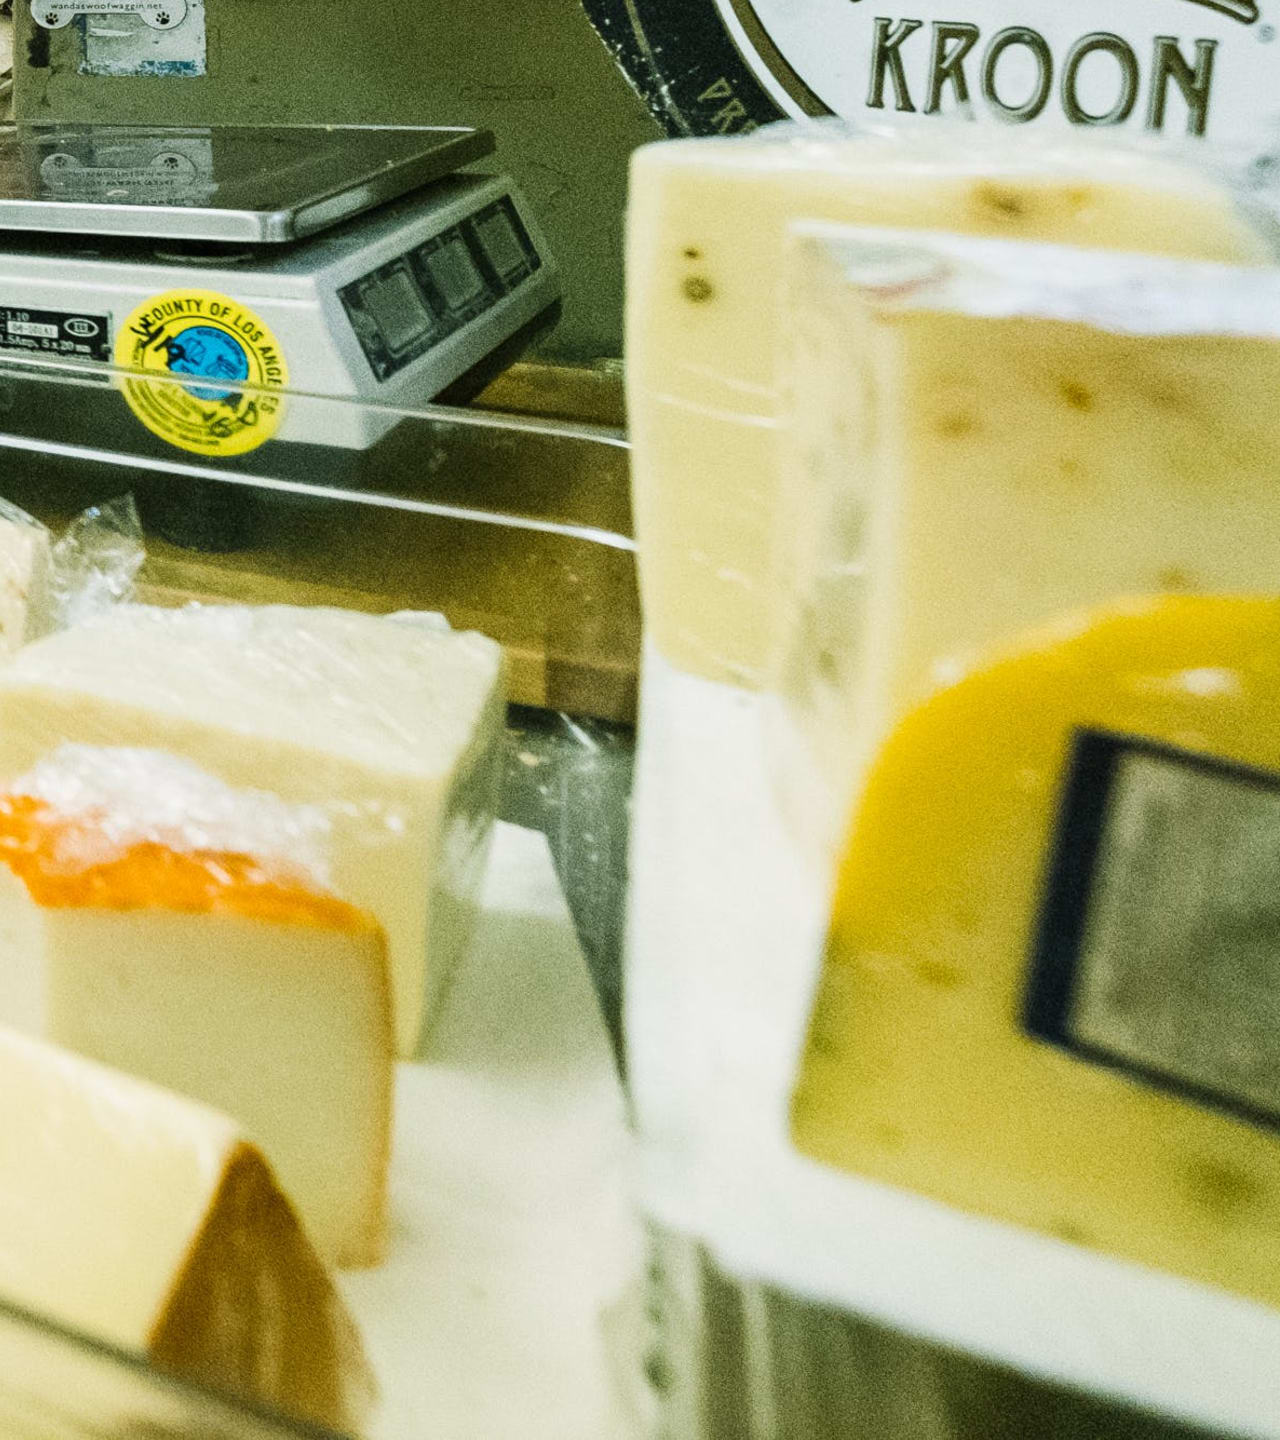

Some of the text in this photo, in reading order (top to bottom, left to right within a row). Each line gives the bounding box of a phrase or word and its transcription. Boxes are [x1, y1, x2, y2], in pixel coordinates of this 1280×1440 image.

[864, 17, 1220, 137] KROON
[143, 298, 282, 415] COUNTY OF LOS ANGEES
